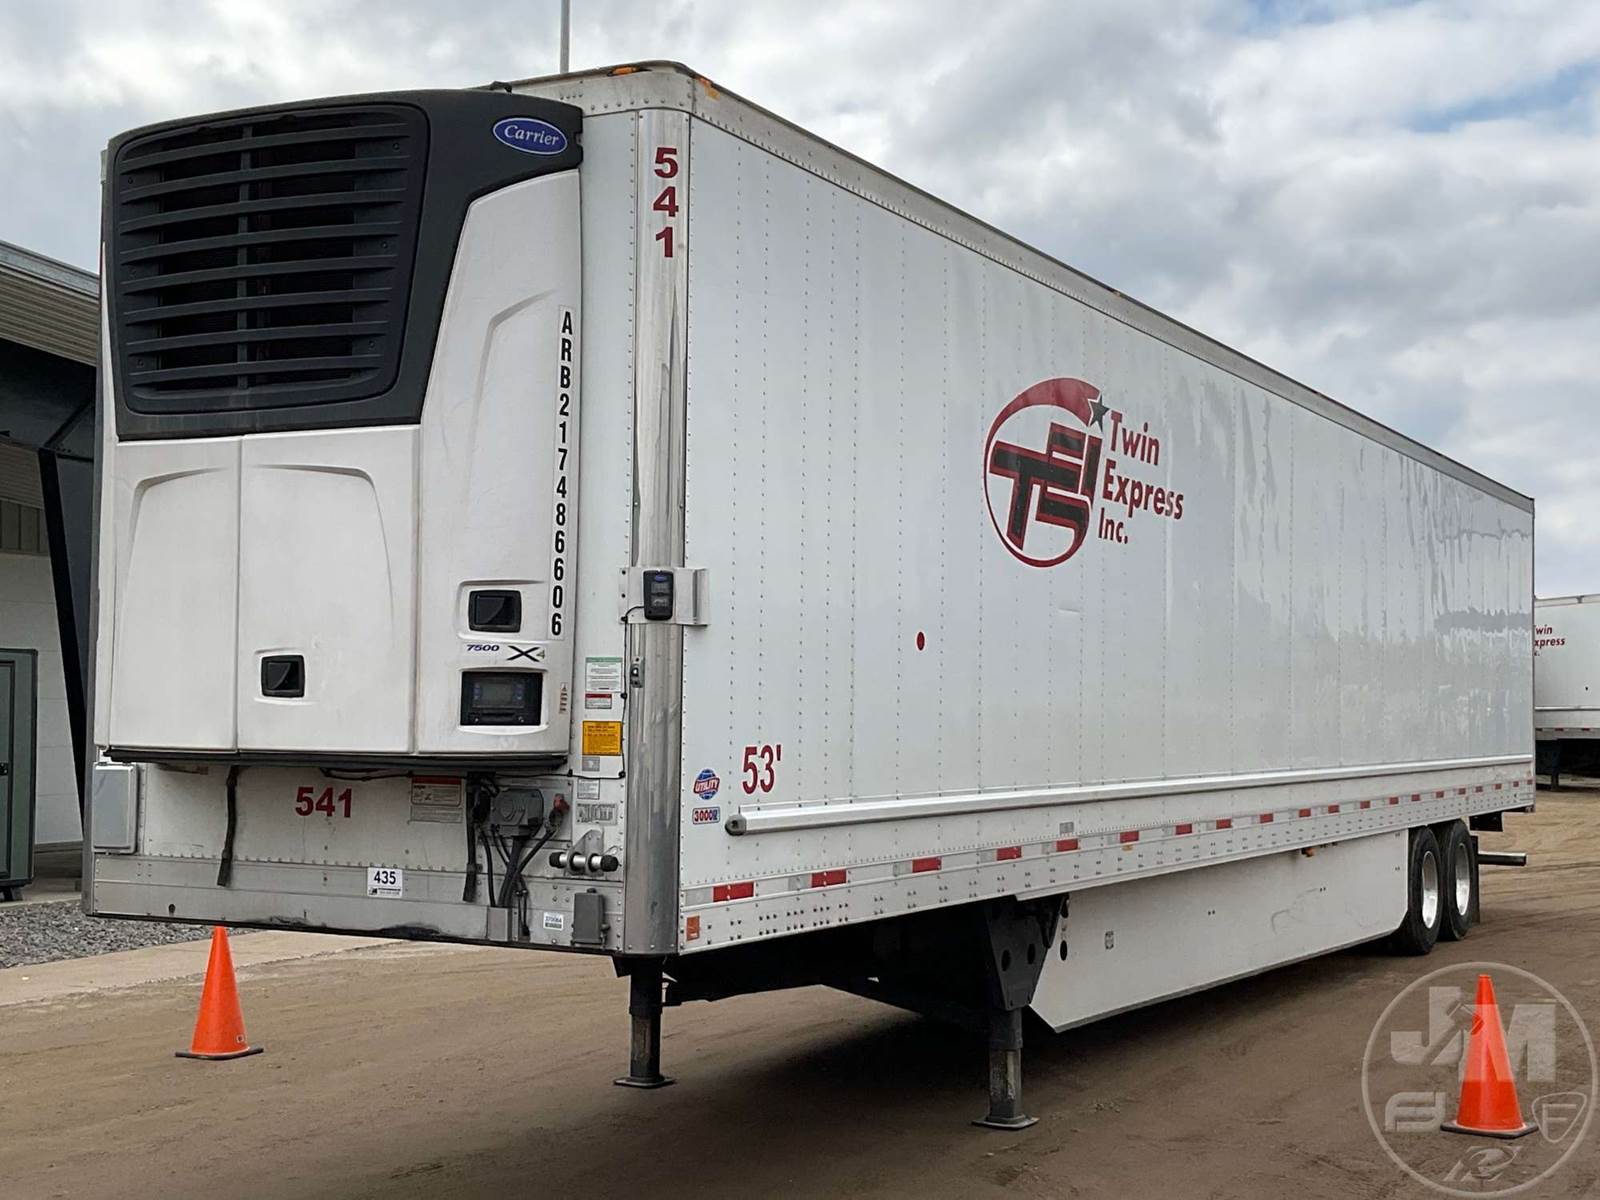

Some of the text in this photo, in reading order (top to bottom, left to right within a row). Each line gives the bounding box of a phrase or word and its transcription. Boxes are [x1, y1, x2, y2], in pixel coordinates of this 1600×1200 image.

[503, 124, 560, 147] Carrier
[653, 147, 679, 258] 541
[1110, 410, 1160, 466] Twin
[551, 311, 573, 636] ARB217486606
[1102, 458, 1184, 520] Express
[1098, 507, 1129, 544] Inc.
[1534, 638, 1566, 650] xpress
[1535, 624, 1553, 635] win
[466, 644, 500, 652] 7500
[742, 744, 781, 795] 53'
[295, 786, 352, 818] 541
[694, 779, 719, 793] UTILITY
[373, 870, 397, 885] 435
